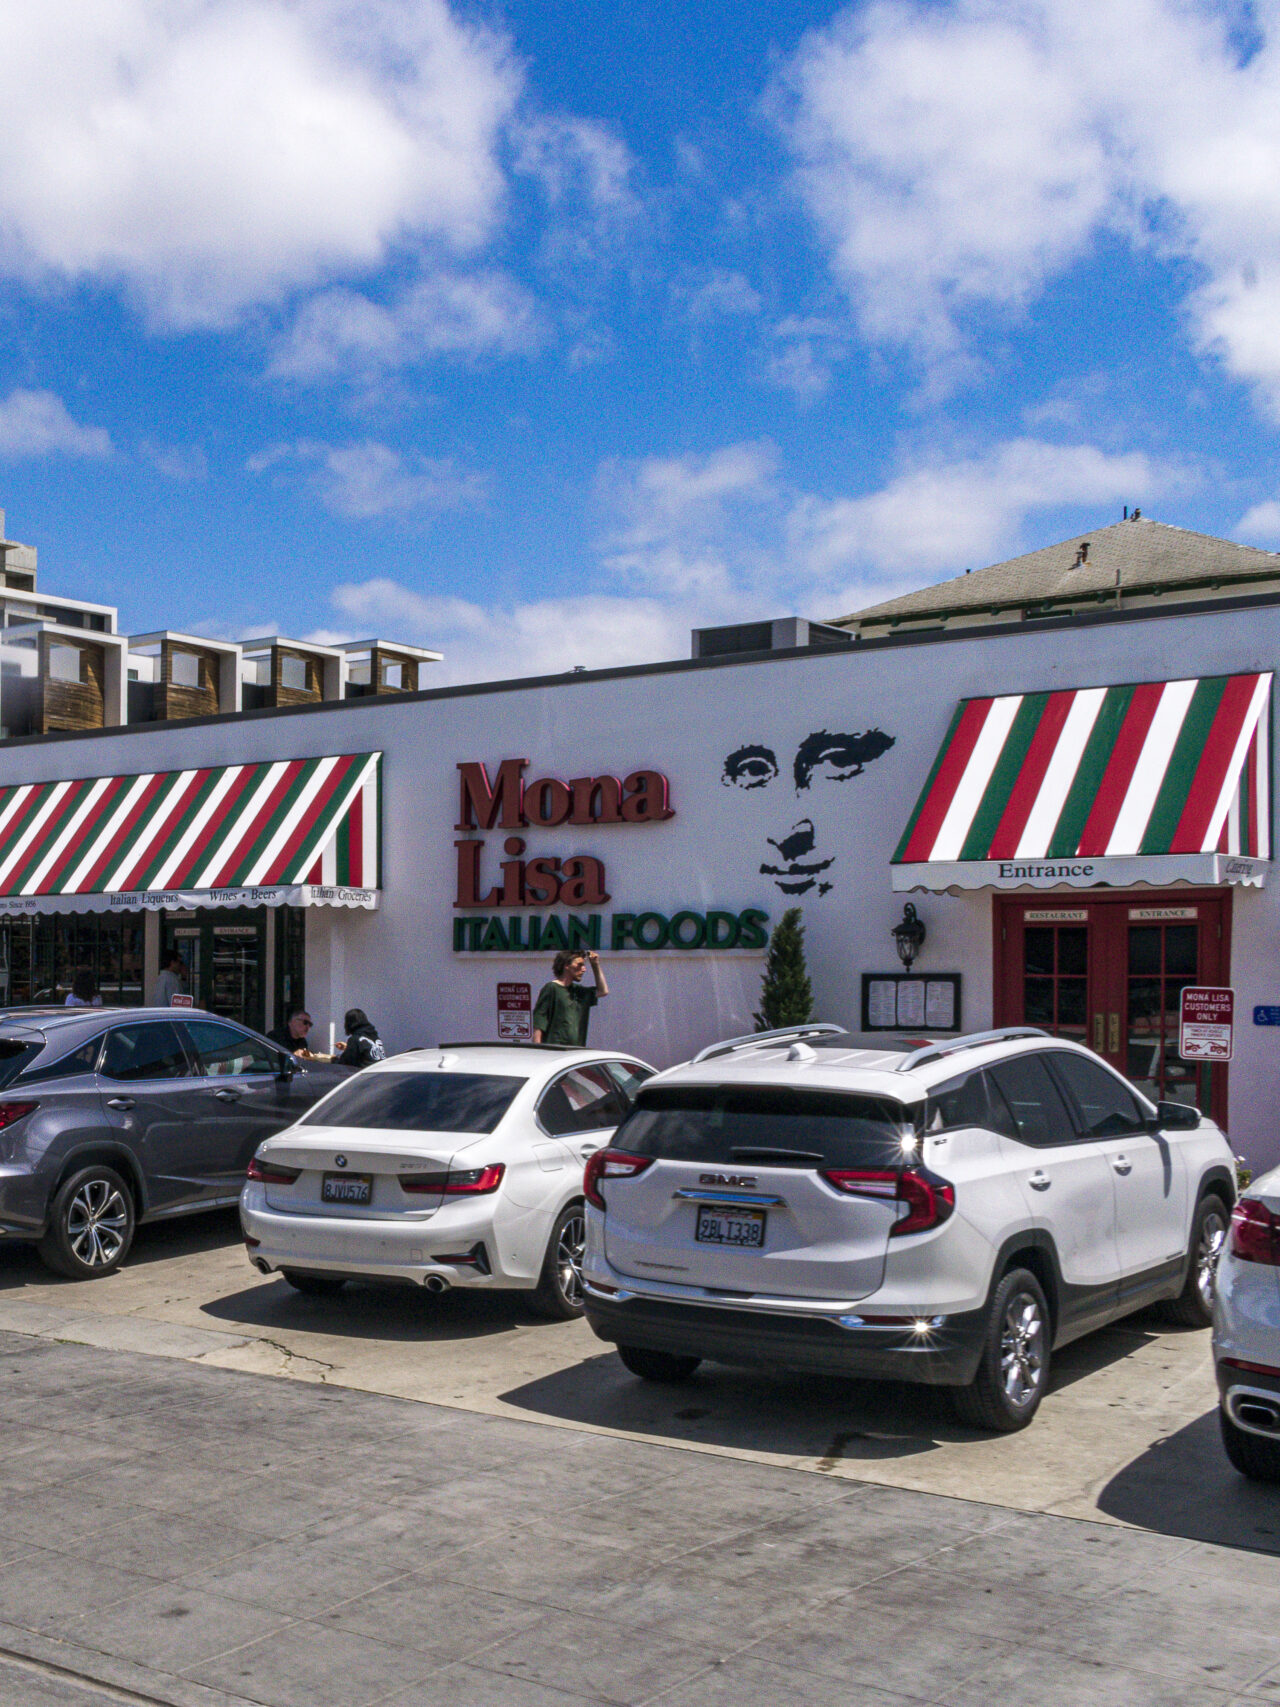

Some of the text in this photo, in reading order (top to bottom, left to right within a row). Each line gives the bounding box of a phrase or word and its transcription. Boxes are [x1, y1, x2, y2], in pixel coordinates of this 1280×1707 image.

[455, 759, 675, 830] Mona
[453, 837, 611, 908] Lisa
[999, 864, 1093, 878] Entrance
[110, 895, 137, 905] Italian
[210, 889, 276, 900] Wines Beers
[311, 886, 371, 901] Italian Groceries
[453, 909, 769, 951] ITALIAN FOODS
[1212, 994, 1229, 1002] LISA
[1185, 1003, 1231, 1012] CUSTOMERS
[699, 1174, 759, 1187] GMC
[326, 1184, 368, 1200] 8JVU576
